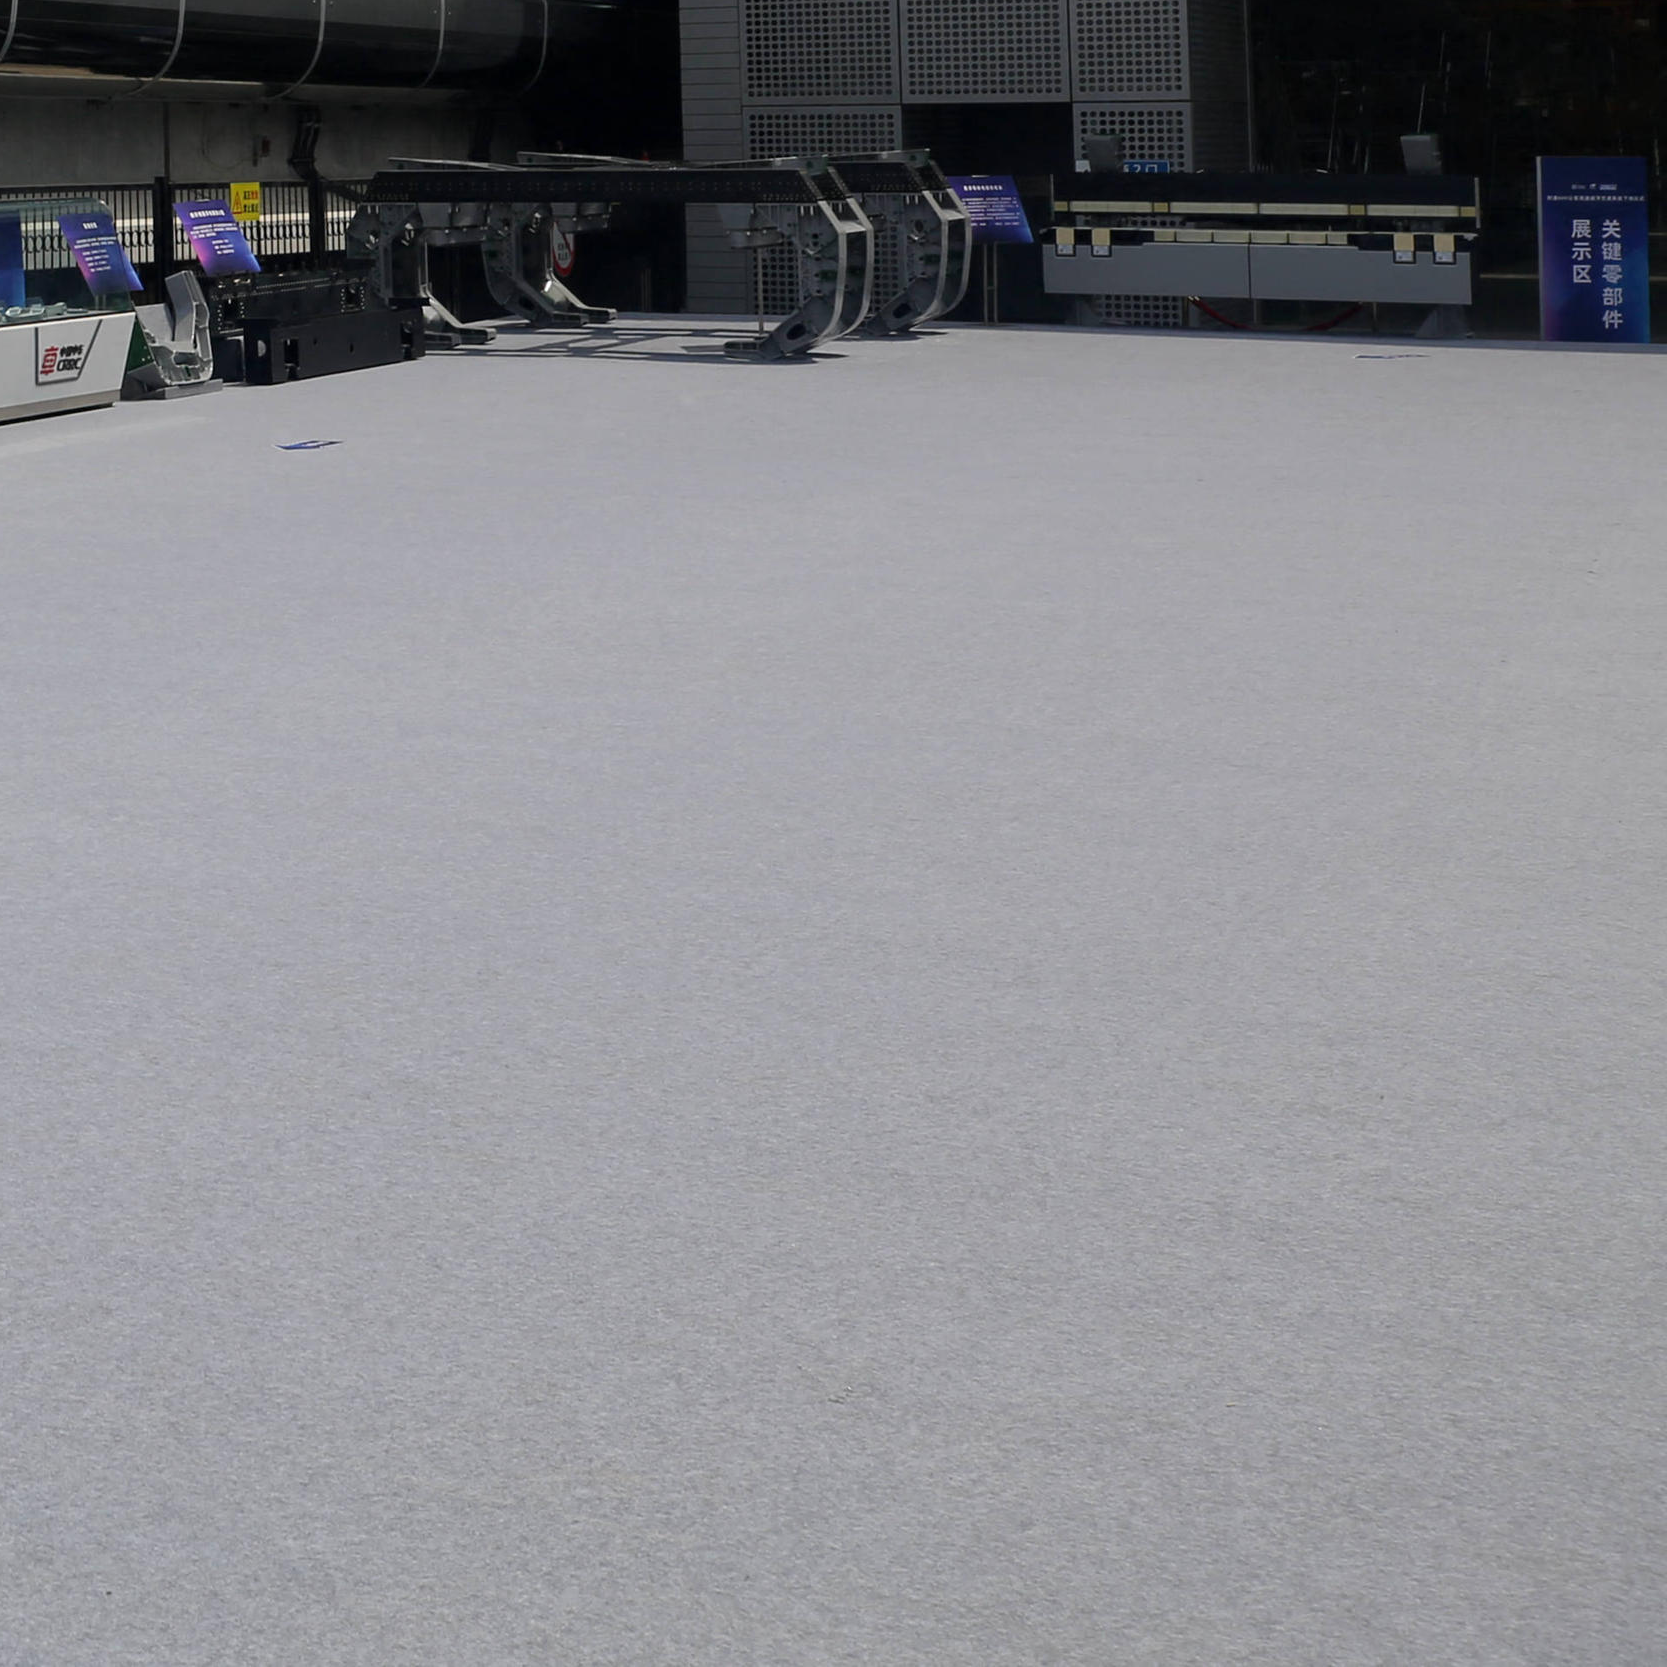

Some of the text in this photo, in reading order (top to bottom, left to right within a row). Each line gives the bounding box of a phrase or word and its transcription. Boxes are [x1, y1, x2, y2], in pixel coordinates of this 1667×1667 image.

[1571, 219, 1592, 283] 展示区
[1602, 219, 1623, 329] 关键零部件
